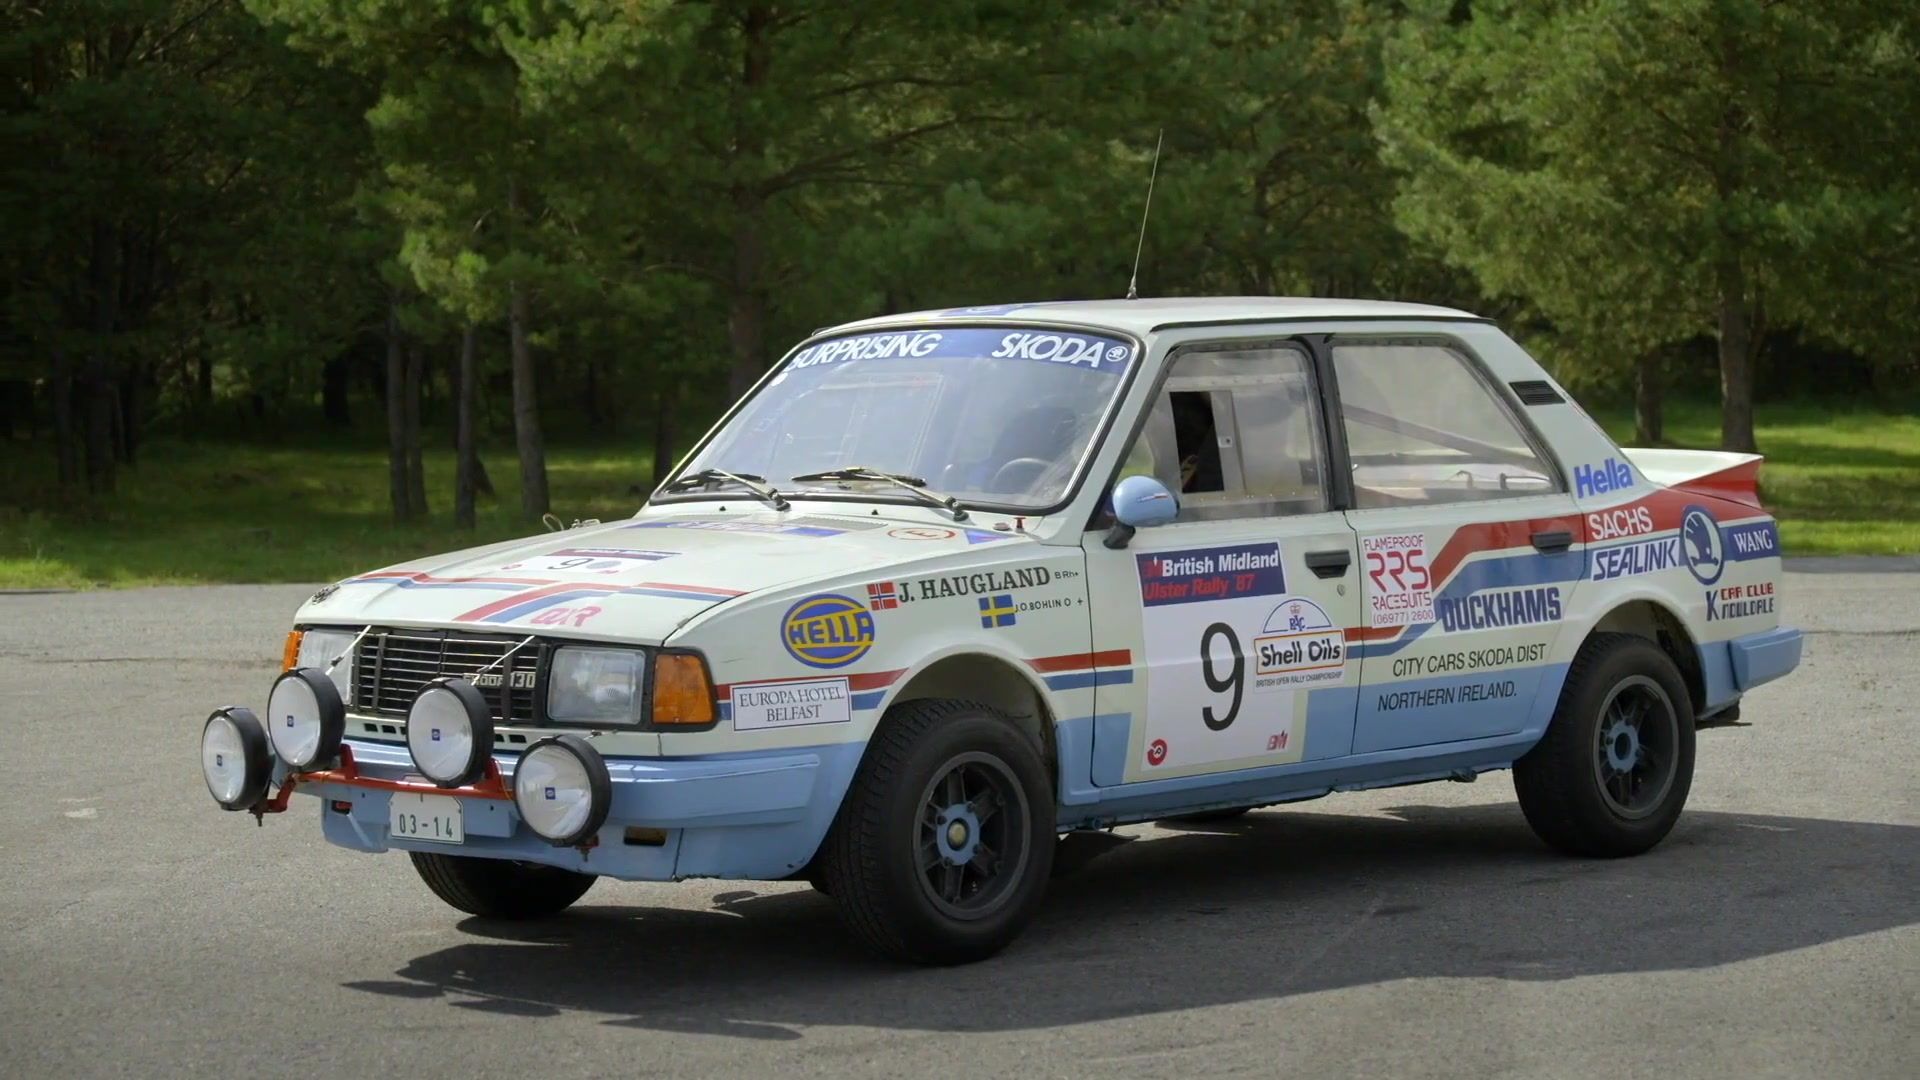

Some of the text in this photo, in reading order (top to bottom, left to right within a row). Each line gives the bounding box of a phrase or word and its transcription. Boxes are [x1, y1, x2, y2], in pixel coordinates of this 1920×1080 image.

[784, 333, 1106, 371] SURPRISING SKODA
[1574, 458, 1634, 498] Hella
[1589, 506, 1653, 540] SACHS
[1363, 534, 1424, 551] FLAMEPROOF
[1733, 529, 1773, 553] WANG
[1162, 556, 1214, 577] British
[1219, 549, 1279, 572] Midland
[1366, 549, 1429, 593] RRS
[1593, 539, 1677, 581] SEALINK
[898, 582, 915, 603] J.
[918, 566, 1050, 600] HAUGLAND
[1145, 582, 1188, 600] Ulster
[1191, 576, 1229, 597] Rally
[1721, 582, 1774, 600] CAR CLUB
[1372, 592, 1432, 610] RACESUITS
[1440, 587, 1561, 633] DUCKHAMS
[787, 612, 875, 645] HELLA
[1373, 609, 1434, 625] (06977) 2600
[1261, 638, 1341, 667] Shell Oils
[1393, 643, 1547, 677] CITY CARS SKODA DIST
[510, 672, 536, 688] 130
[1200, 622, 1245, 731] 9
[739, 686, 845, 707] EUROPA HOTEL
[1378, 680, 1517, 712] NORTHERN IRELAND.
[766, 704, 822, 722] BELFAST
[399, 813, 453, 838] 03-14
